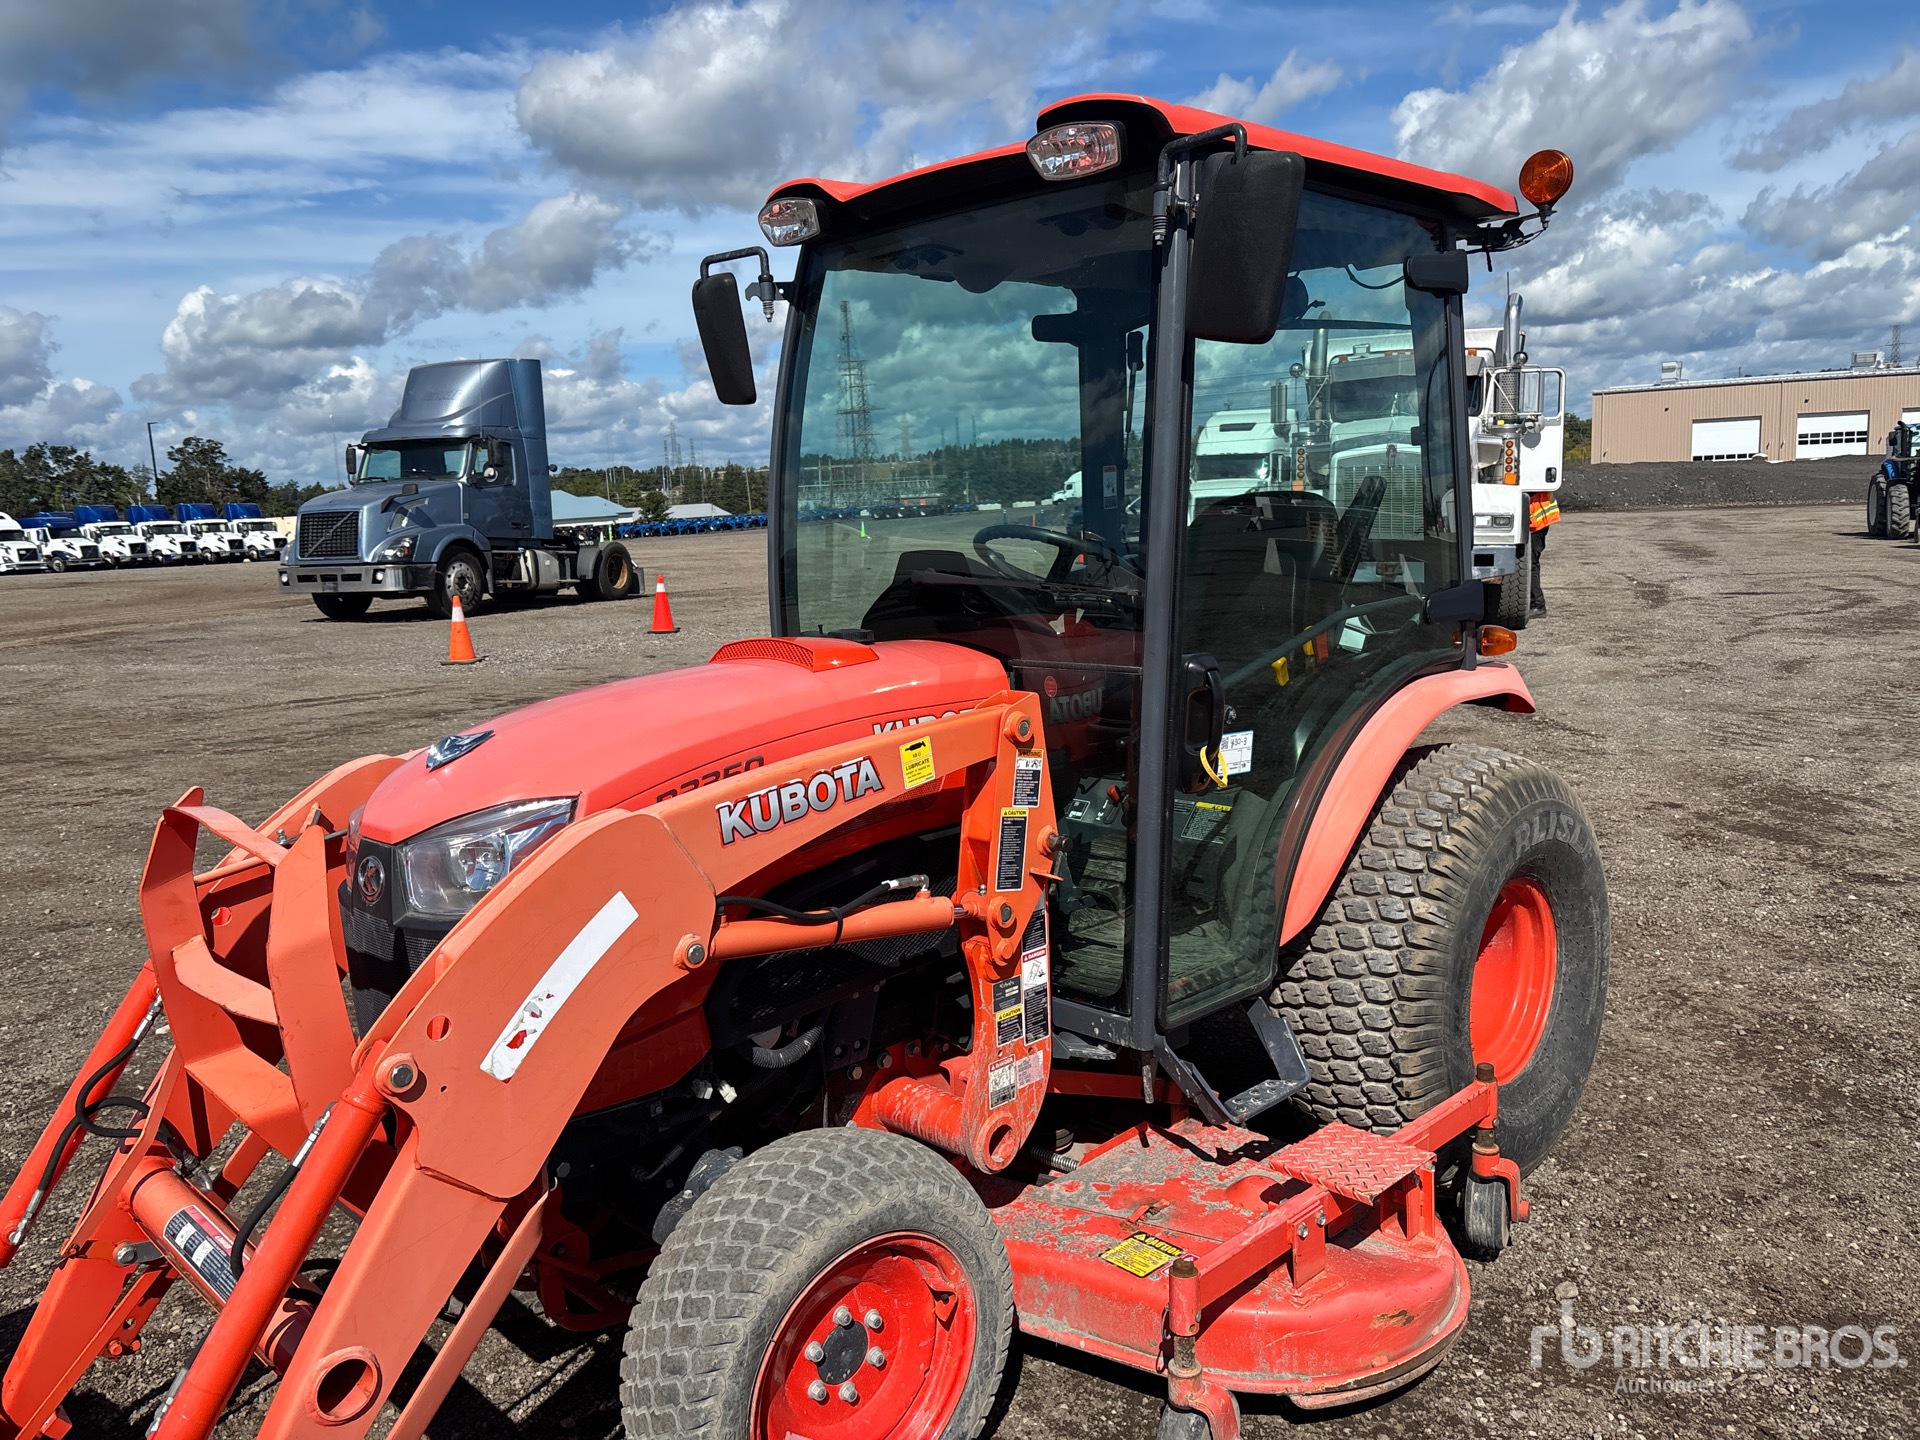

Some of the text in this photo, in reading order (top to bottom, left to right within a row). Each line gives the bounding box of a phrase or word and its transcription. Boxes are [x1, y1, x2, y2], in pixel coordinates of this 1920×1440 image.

[905, 758, 930, 771] LUBRICATE
[717, 755, 883, 846] KUBOTA
[1028, 949, 1046, 960] DANGER
[1003, 1008, 1021, 1018] CAUTION
[1144, 1236, 1182, 1257] CAUTION
